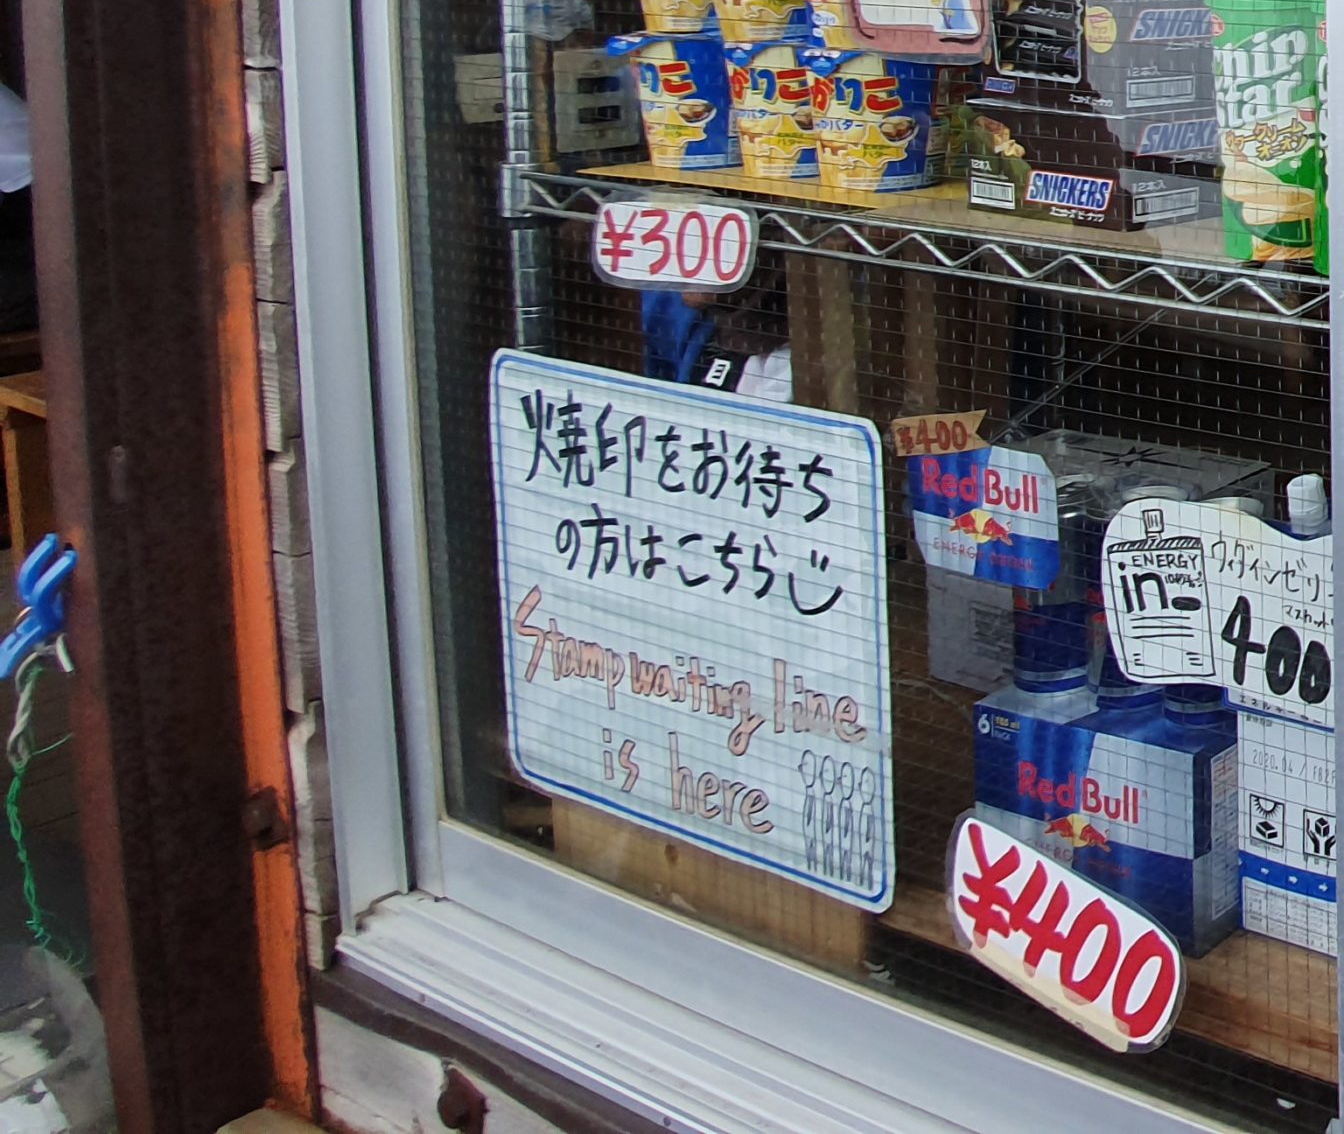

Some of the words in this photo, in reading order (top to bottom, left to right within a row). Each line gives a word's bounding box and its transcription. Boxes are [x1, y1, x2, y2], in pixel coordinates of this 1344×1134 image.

[810, 76, 904, 116] がりこ
[1256, 134, 1309, 161] オニオン
[1029, 172, 1111, 210] SNICKERS
[599, 208, 749, 283] ¥300
[519, 388, 835, 524] 焼印をお待ち
[921, 457, 979, 503] Red
[983, 468, 1039, 514] Bull
[555, 502, 779, 599] の方はこちら
[1131, 553, 1199, 568] ENERGY
[1118, 561, 1170, 614] in
[514, 584, 626, 711] Stamp
[628, 650, 767, 757] waiting
[773, 658, 868, 745] line
[1221, 595, 1332, 705] 400
[977, 713, 991, 735] 6
[602, 727, 641, 794] is
[667, 730, 776, 835] here
[1017, 759, 1077, 809] Red
[1081, 777, 1139, 825] Bull
[957, 821, 1177, 1039] ¥400
